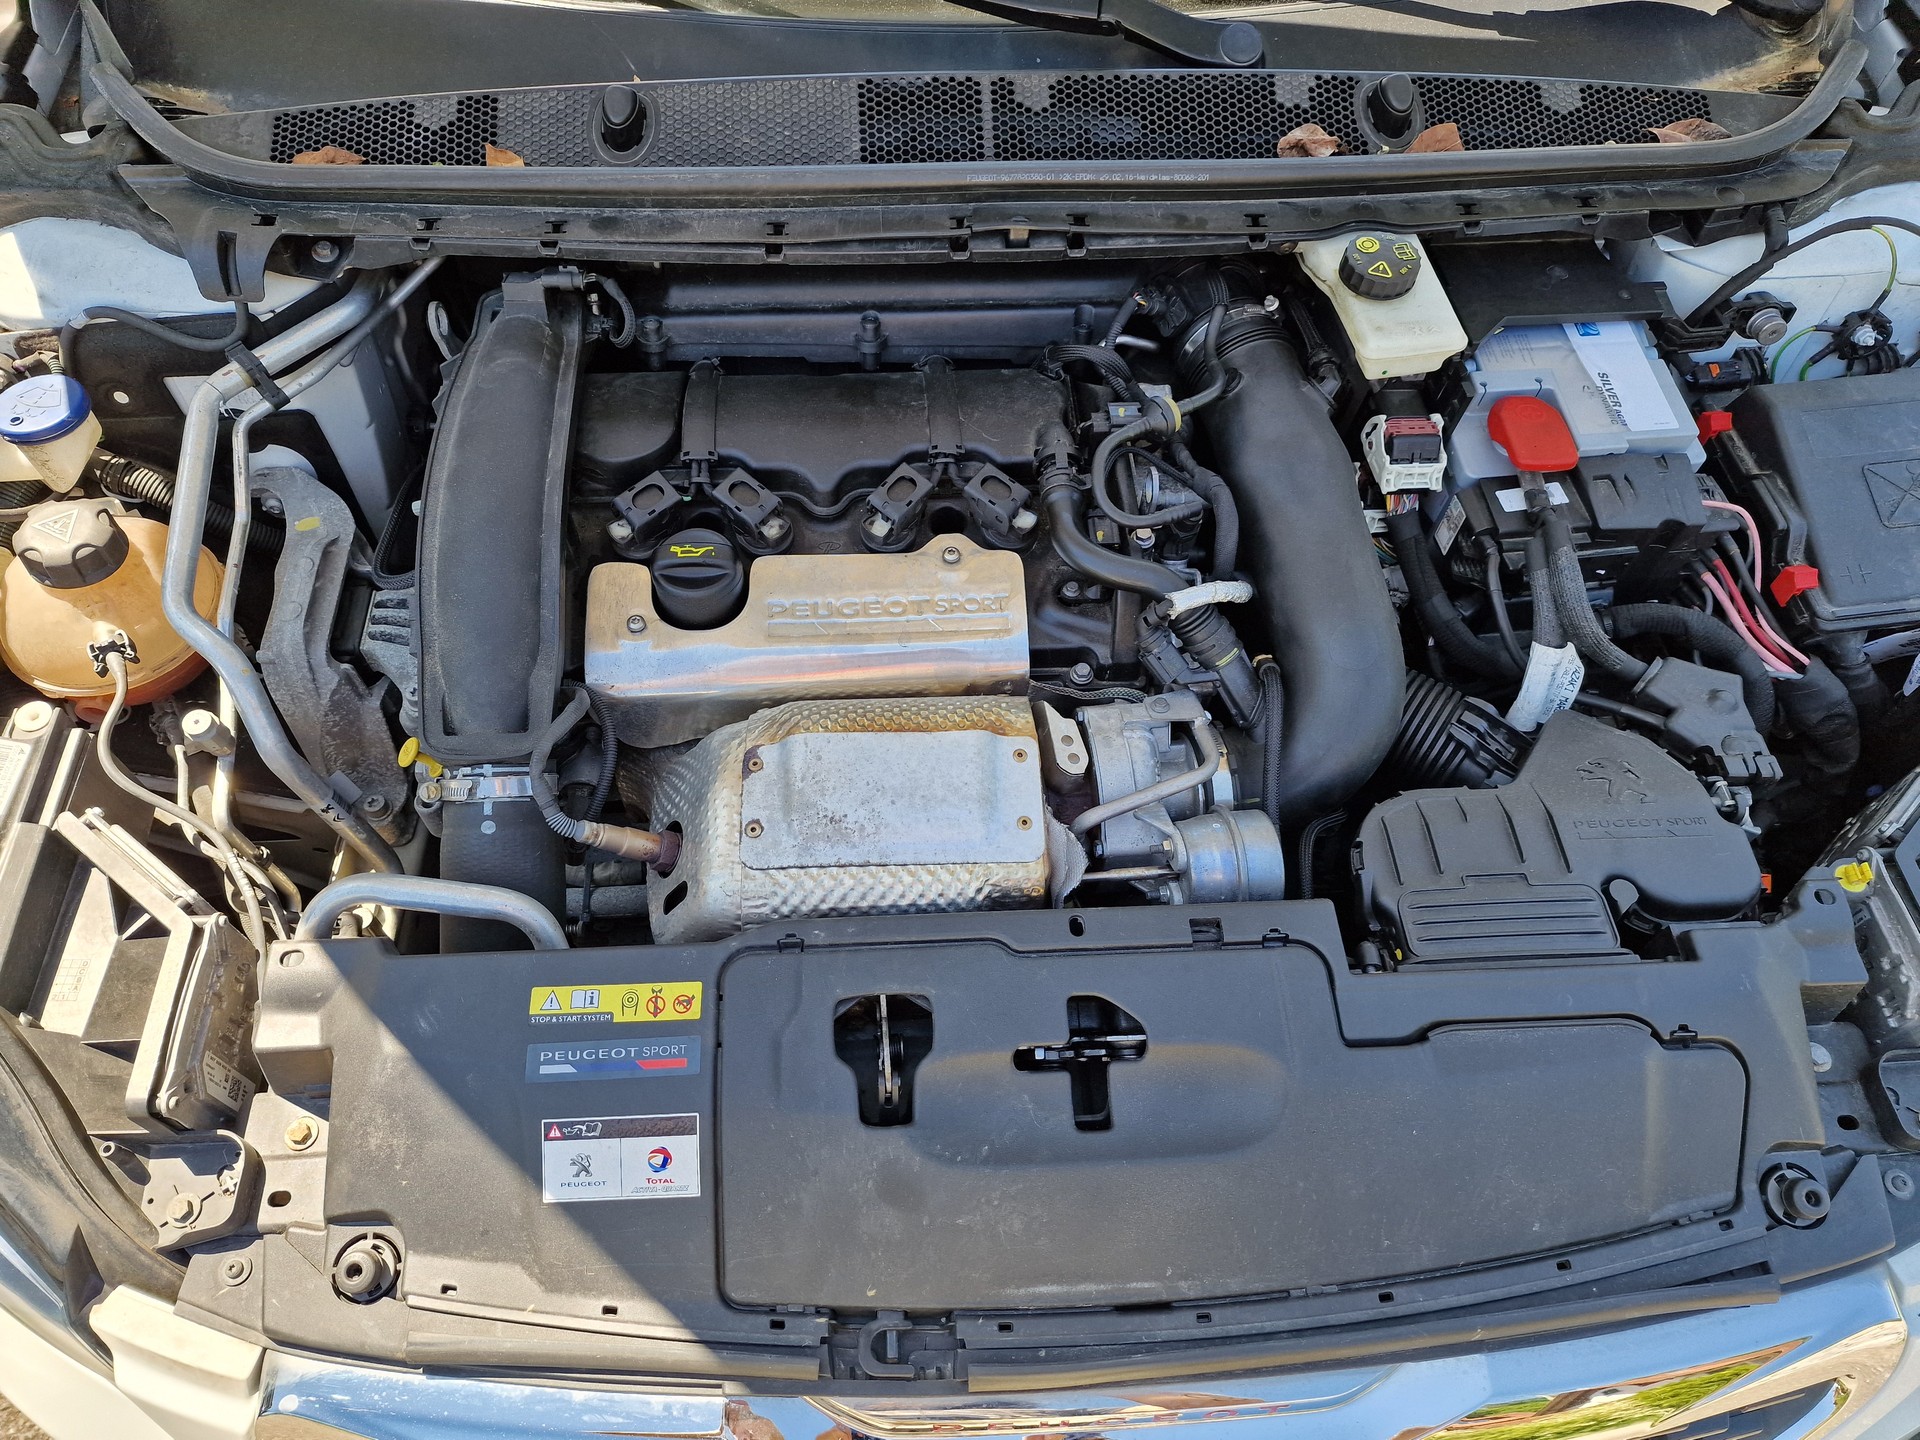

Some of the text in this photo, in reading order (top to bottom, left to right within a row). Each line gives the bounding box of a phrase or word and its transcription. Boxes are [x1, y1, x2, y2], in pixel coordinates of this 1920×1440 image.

[1595, 385, 1619, 425] DYNAMIC
[1597, 372, 1628, 427] SILVER AGM
[767, 593, 1009, 618] PEUGEOT SPORT
[1564, 664, 1582, 692] YAZAKI
[1573, 816, 1708, 829] PEUGEOT SPORT
[583, 1014, 611, 1022] SYSTEM
[540, 1044, 688, 1062] PEUGEOT SPORT
[561, 1180, 607, 1188] PEUGEOT
